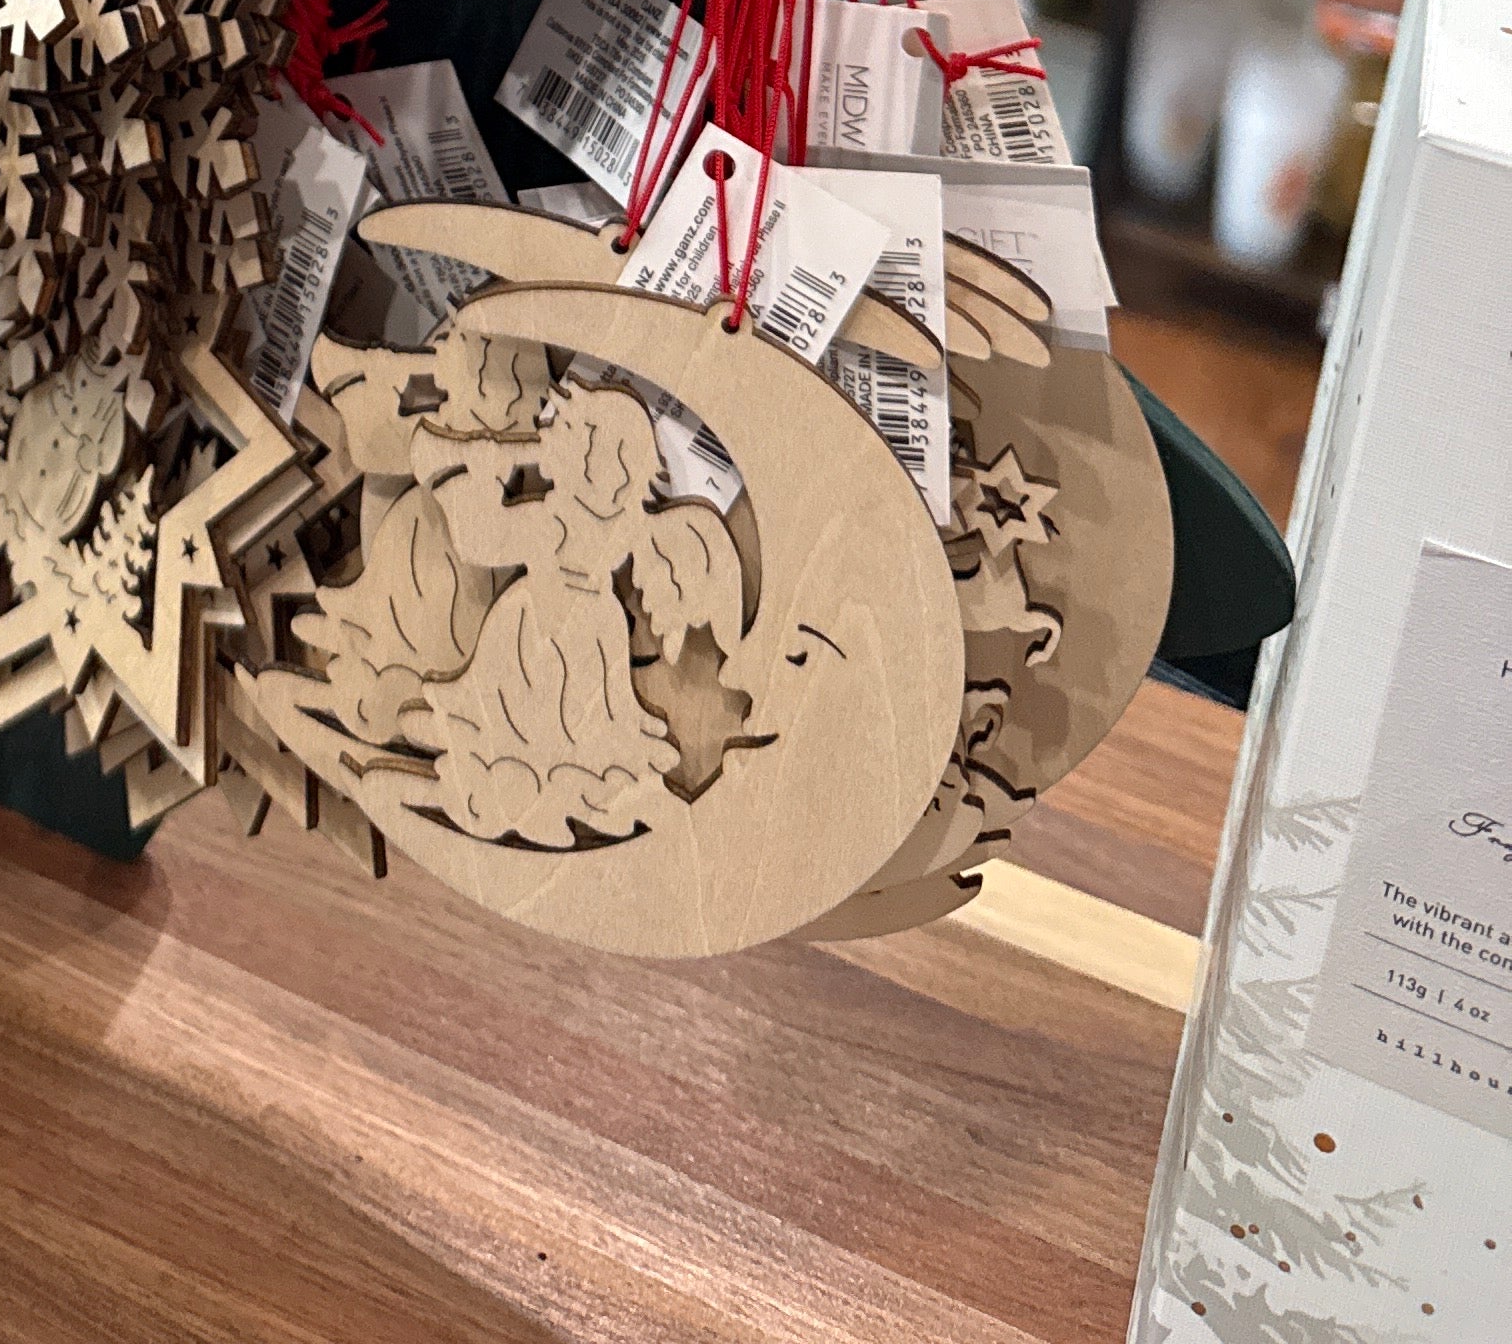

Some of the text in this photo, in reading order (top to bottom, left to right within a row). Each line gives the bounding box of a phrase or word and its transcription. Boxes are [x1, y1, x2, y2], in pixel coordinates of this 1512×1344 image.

[819, 62, 831, 104] MAKE
[841, 65, 869, 146] MIDW
[535, 101, 583, 140] 38449
[582, 135, 617, 174] 15028
[970, 132, 984, 152] PO
[978, 112, 1001, 158] CHINA
[1019, 85, 1054, 154] 15028
[652, 194, 718, 295] www.ganz.com
[755, 206, 782, 241] Phase
[299, 242, 329, 314] 15028
[326, 206, 339, 221] 3
[634, 265, 655, 288] NZ
[674, 269, 692, 289] for
[792, 270, 847, 351] 028 3
[906, 236, 929, 446] 38449 3
[842, 366, 857, 396] 5727
[856, 353, 874, 415] MADE IN
[705, 475, 721, 491] 7
[1382, 880, 1495, 940] The vibrant
[1392, 913, 1435, 941] with
[1441, 930, 1473, 955] the
[1387, 969, 1491, 1023] 113g 4 oz
